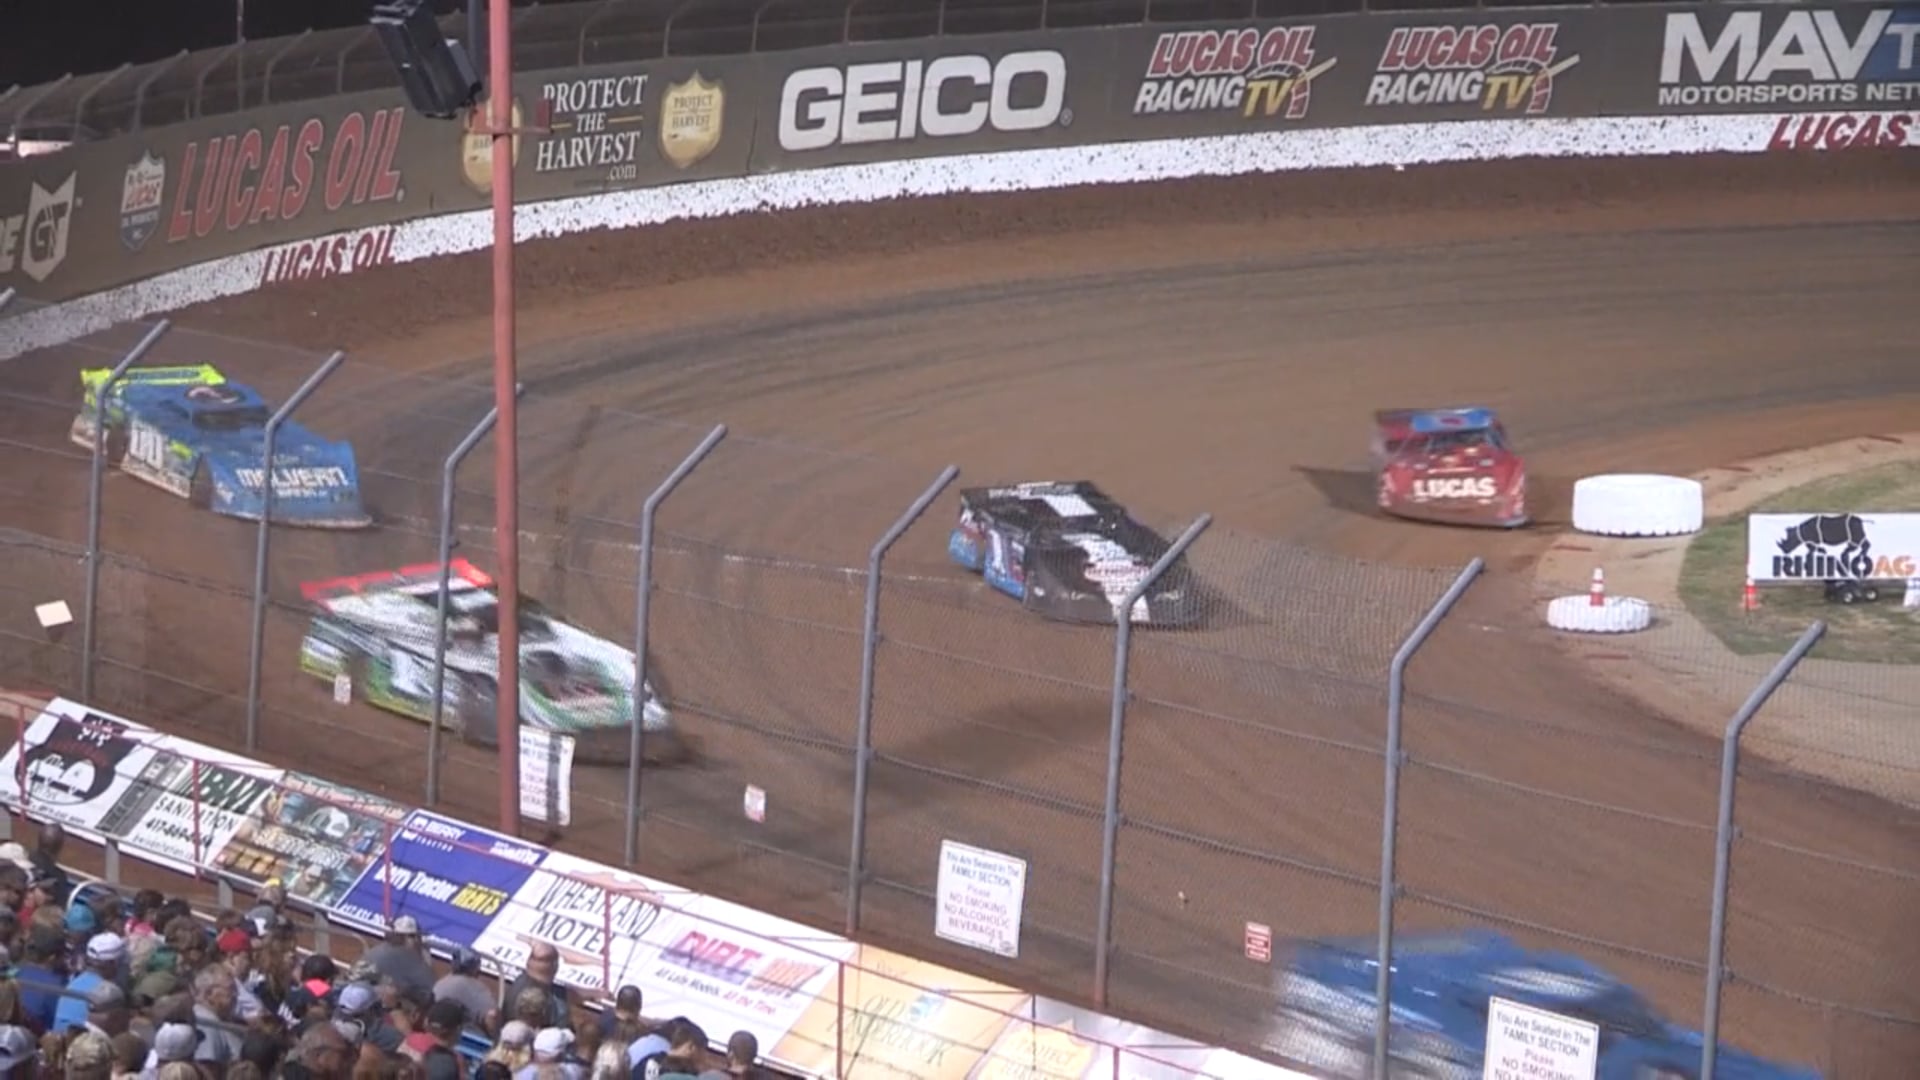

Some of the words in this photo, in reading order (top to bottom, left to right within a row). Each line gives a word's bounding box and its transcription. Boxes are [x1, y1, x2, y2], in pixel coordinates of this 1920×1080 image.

[1145, 28, 1260, 78] LUCAS
[1258, 26, 1316, 68] OIL
[1376, 24, 1500, 72] LUCAS
[1497, 23, 1559, 66] OIL
[543, 75, 649, 113] PROTECT
[673, 93, 714, 109] PROTECT
[778, 49, 1067, 151] GEICO
[1658, 82, 1858, 106] MOTORSPORTS
[576, 111, 607, 133] THE
[671, 114, 711, 129] HARVEST
[1766, 113, 1912, 150] LUCAS
[536, 131, 642, 171] HARVEST
[168, 118, 324, 243] LUCAS
[325, 107, 405, 211] OIL
[605, 164, 637, 181] .com
[0, 214, 24, 272] E
[260, 236, 348, 288] LUCAS
[351, 228, 397, 272] OIL
[1413, 477, 1497, 498] LUCAS
[374, 862, 413, 890] Brry
[951, 864, 977, 879] FAMILY
[979, 871, 1011, 887] SECTION
[944, 902, 958, 914] NO
[958, 906, 1010, 929] ALCOHOLIC
[950, 892, 963, 904] NO
[965, 896, 1008, 916] SMOKING
[1497, 1011, 1513, 1023] You
[1514, 1016, 1529, 1029] Are
[1531, 1019, 1561, 1038] Seated
[1574, 1031, 1591, 1046] The
[1503, 1026, 1536, 1045] FAMILY
[1538, 1037, 1580, 1057] SECTION
[1502, 1056, 1519, 1071] NO
[1524, 1048, 1555, 1066] Please
